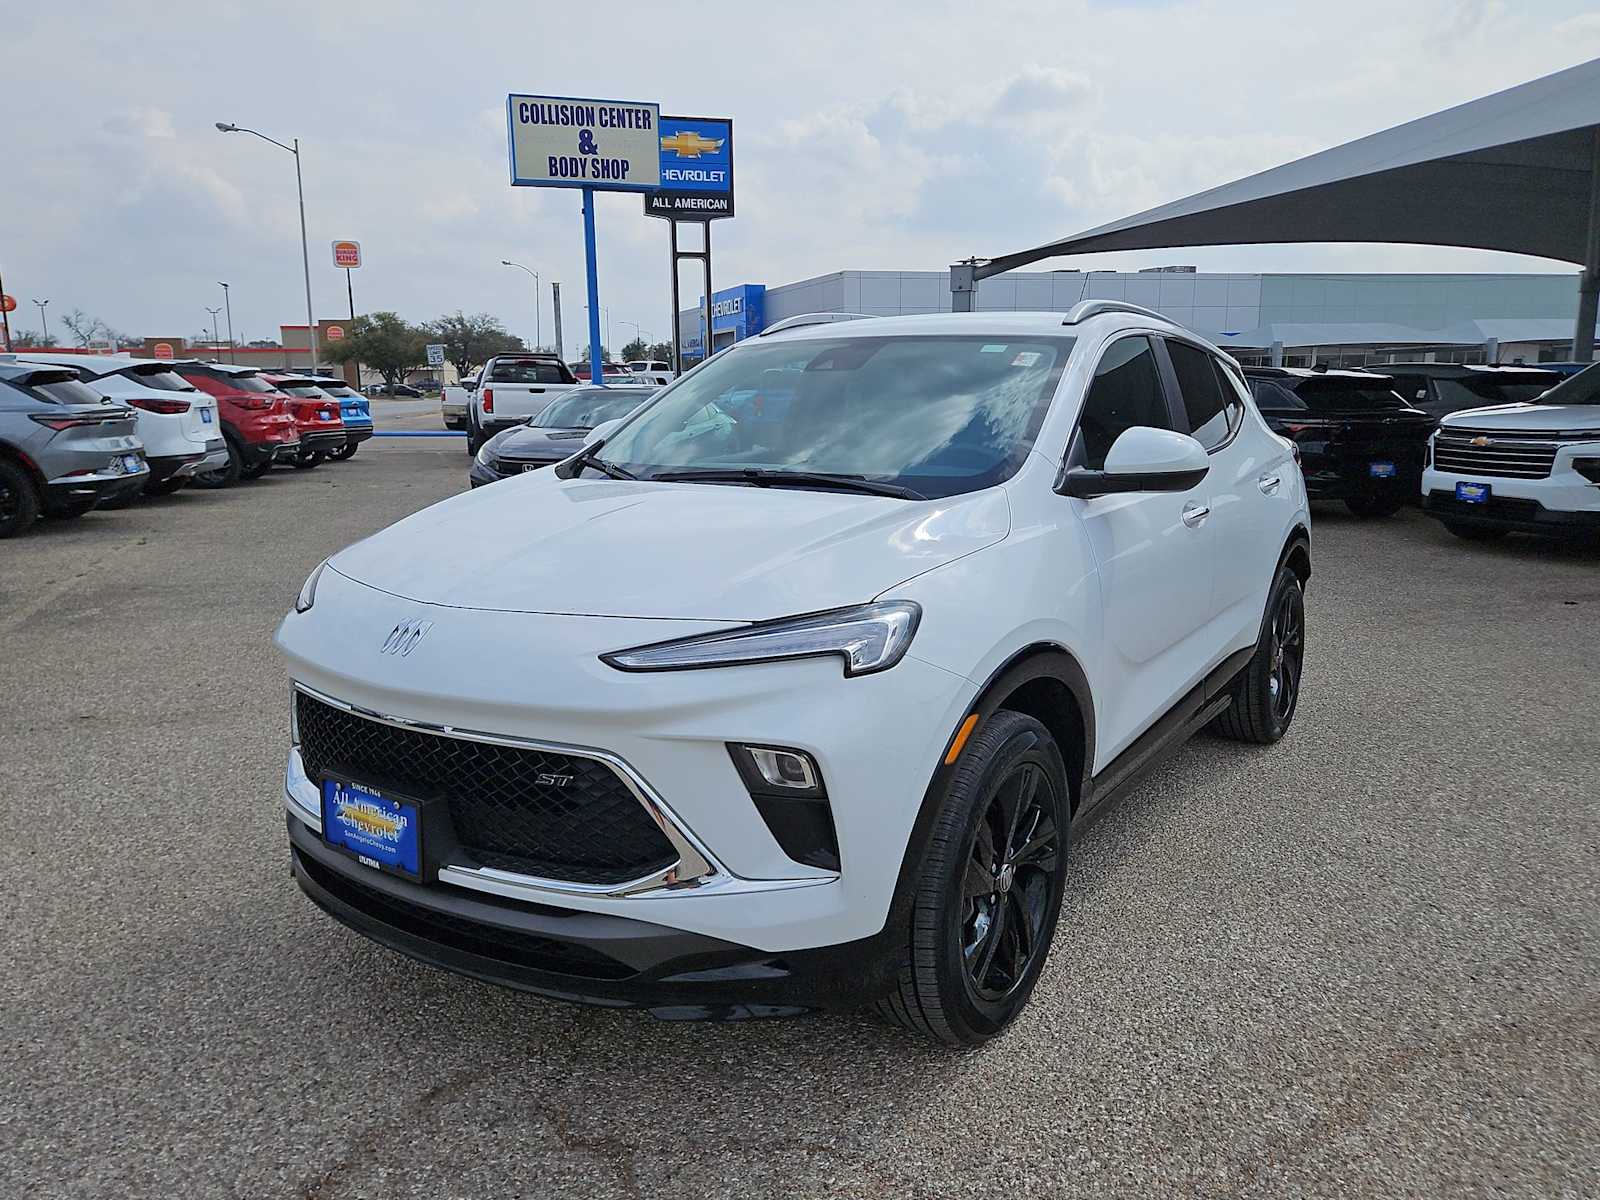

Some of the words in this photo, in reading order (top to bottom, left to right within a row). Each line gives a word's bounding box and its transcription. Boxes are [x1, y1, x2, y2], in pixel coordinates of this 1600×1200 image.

[519, 102, 595, 127] COLLISION
[600, 106, 651, 129] CENTER
[578, 128, 598, 155] &
[549, 156, 589, 178] BODY
[591, 158, 629, 180] SHOP
[662, 169, 726, 182] HEVROLET
[652, 197, 672, 208] ALL
[674, 198, 728, 210] AMERICAN
[333, 791, 349, 805] All
[353, 796, 408, 828] American
[342, 812, 399, 843] Chevrolet
